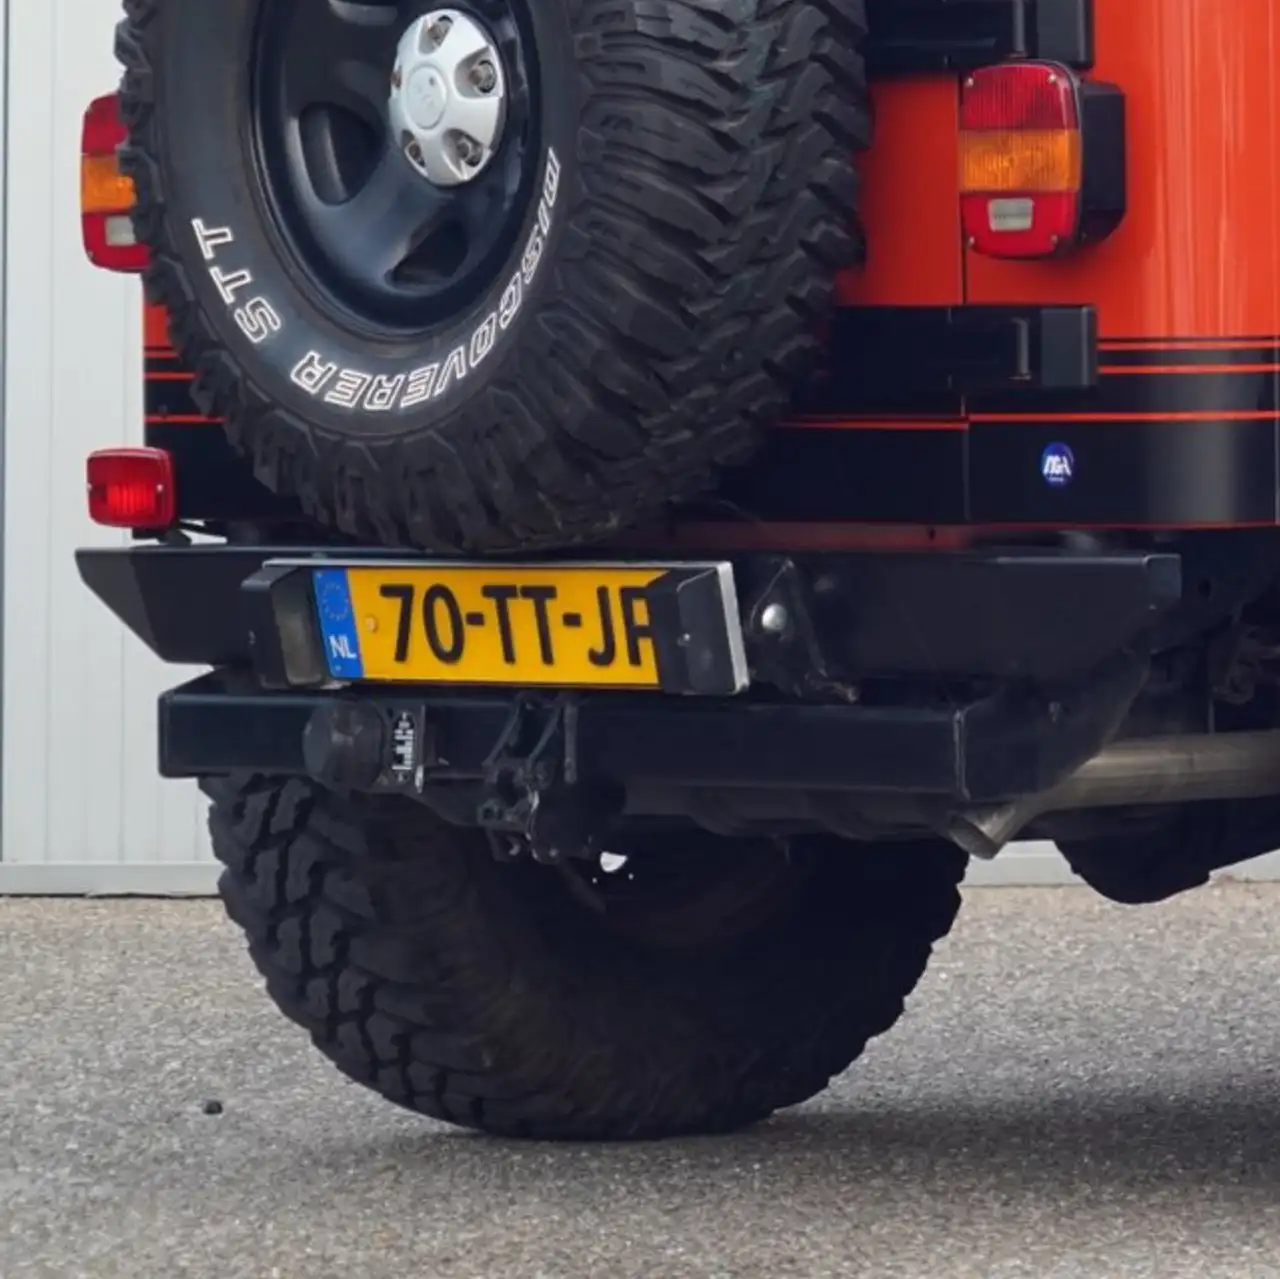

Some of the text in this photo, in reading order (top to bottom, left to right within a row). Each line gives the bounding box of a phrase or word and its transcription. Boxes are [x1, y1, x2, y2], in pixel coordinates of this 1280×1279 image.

[191, 147, 561, 411] DISCOVERER STT
[329, 634, 358, 660] NL
